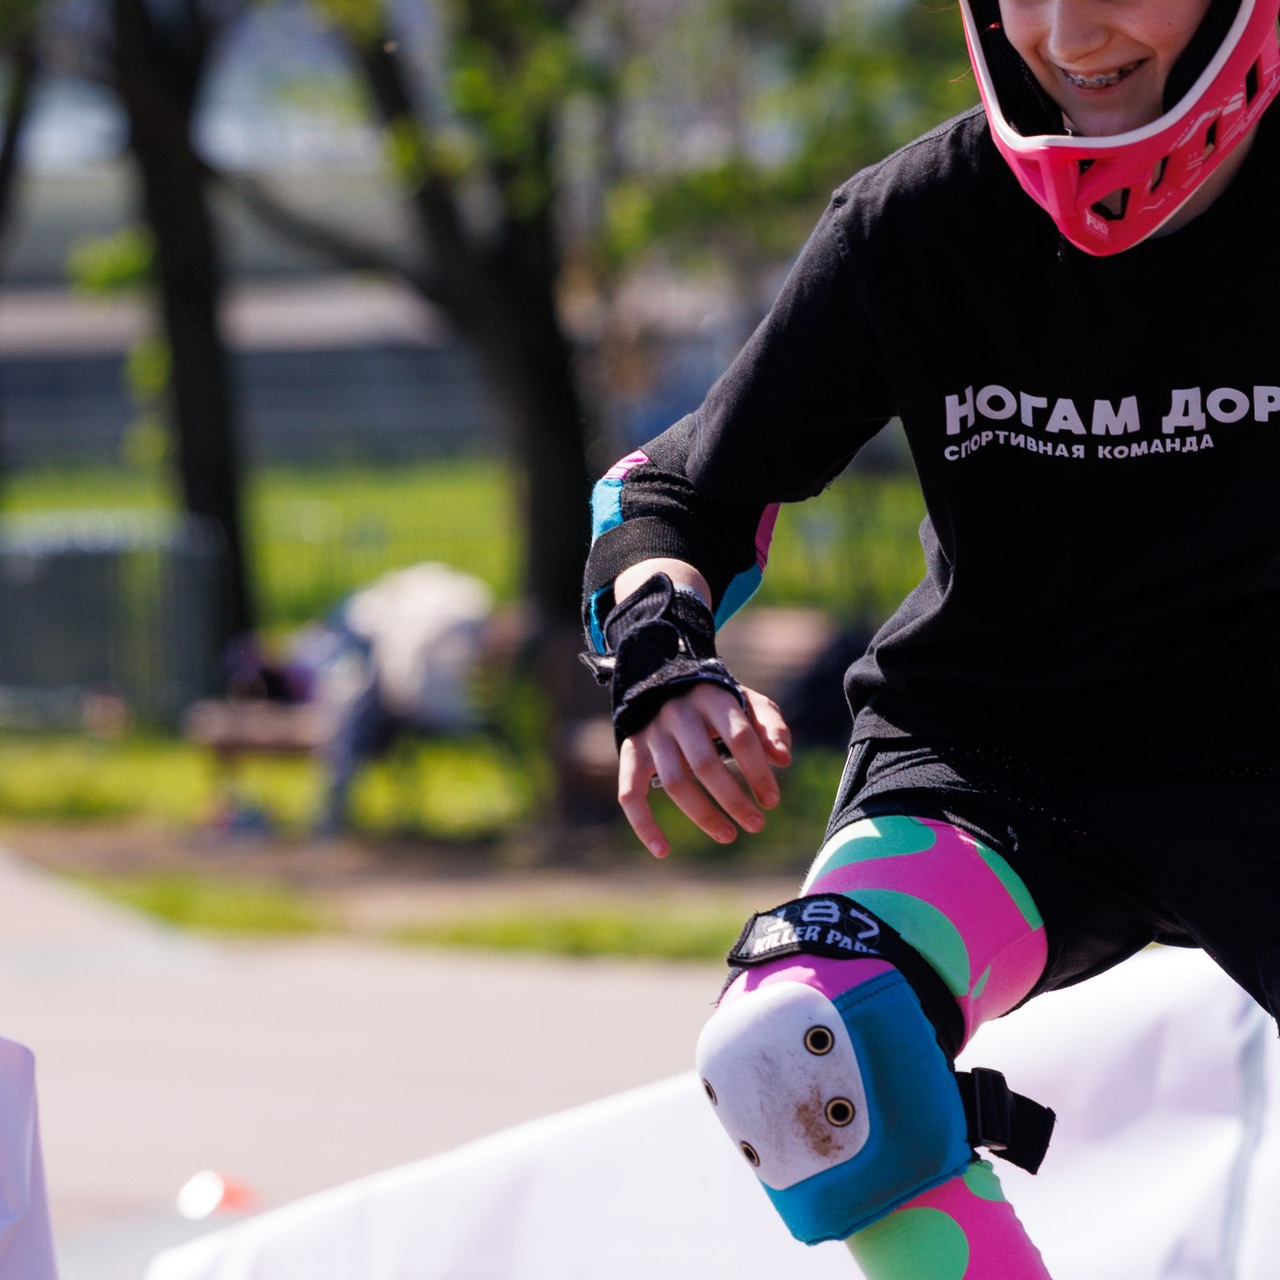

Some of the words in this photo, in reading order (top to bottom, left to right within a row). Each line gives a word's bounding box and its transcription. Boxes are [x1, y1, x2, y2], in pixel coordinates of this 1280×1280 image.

[944, 384, 1141, 435] НОГАМ
[944, 430, 1085, 461] СПОРТИВНАЯ
[1098, 434, 1215, 459] КОМАНДА
[765, 900, 881, 940] 187
[752, 925, 819, 955] KILLER
